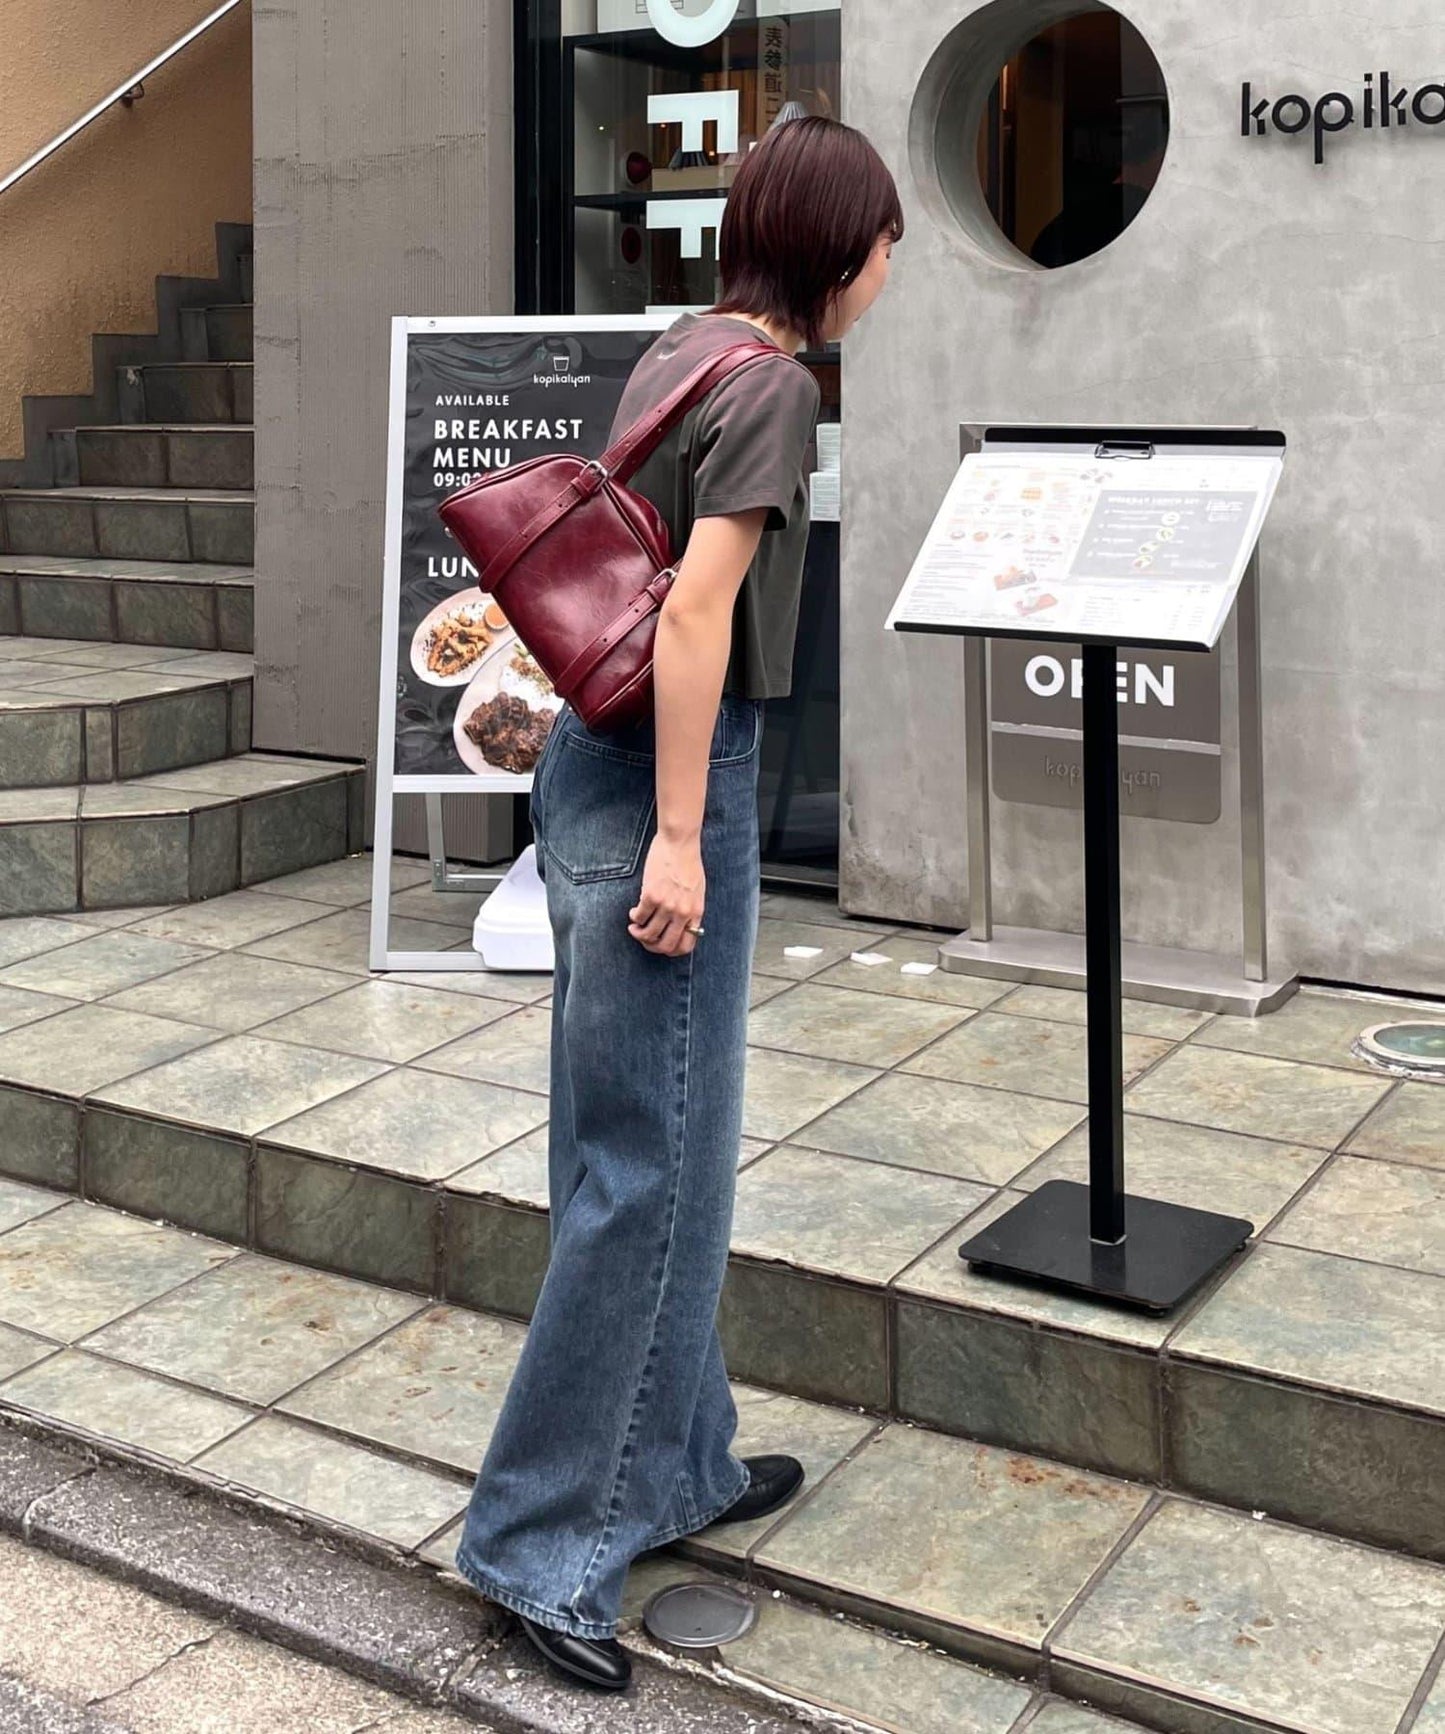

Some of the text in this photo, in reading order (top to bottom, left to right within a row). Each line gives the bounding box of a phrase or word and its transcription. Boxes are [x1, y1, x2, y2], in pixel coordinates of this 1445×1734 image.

[533, 373, 591, 388] kopikalyan
[435, 395, 510, 406] AVAILABLE
[434, 419, 583, 440] BREAKFAST
[433, 447, 511, 468] MENU
